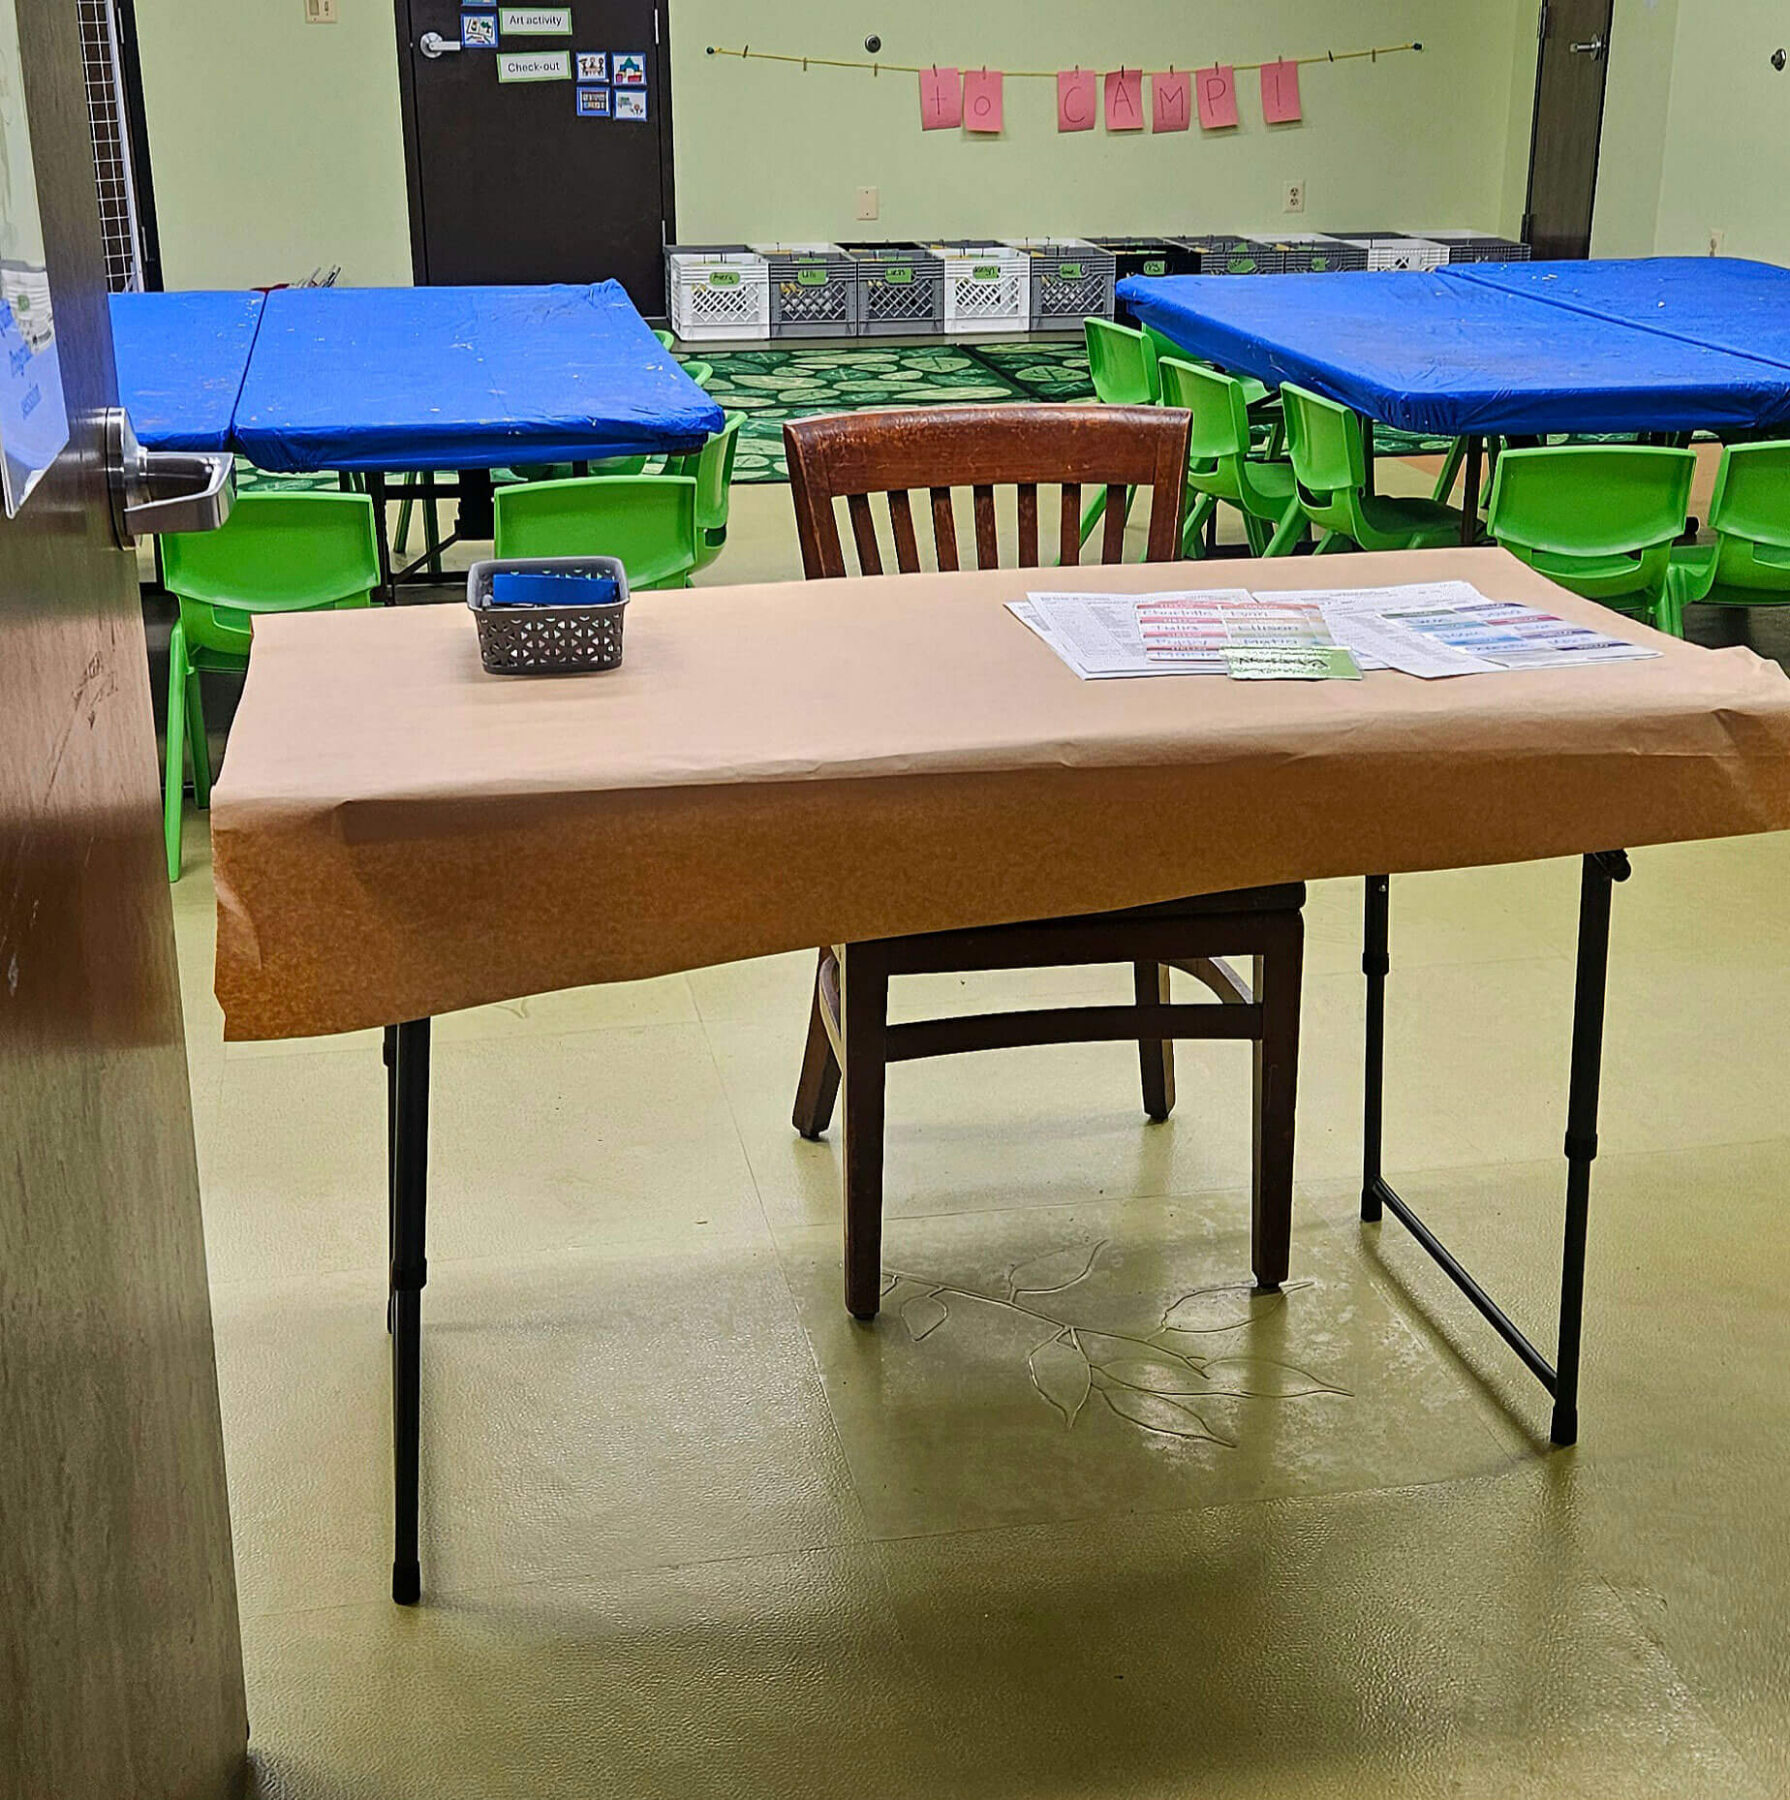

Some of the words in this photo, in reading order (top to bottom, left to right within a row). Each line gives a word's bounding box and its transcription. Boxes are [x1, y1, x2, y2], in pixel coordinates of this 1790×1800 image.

[509, 15, 525, 25] Art
[526, 15, 562, 27] activity
[507, 61, 560, 73] Check-out
